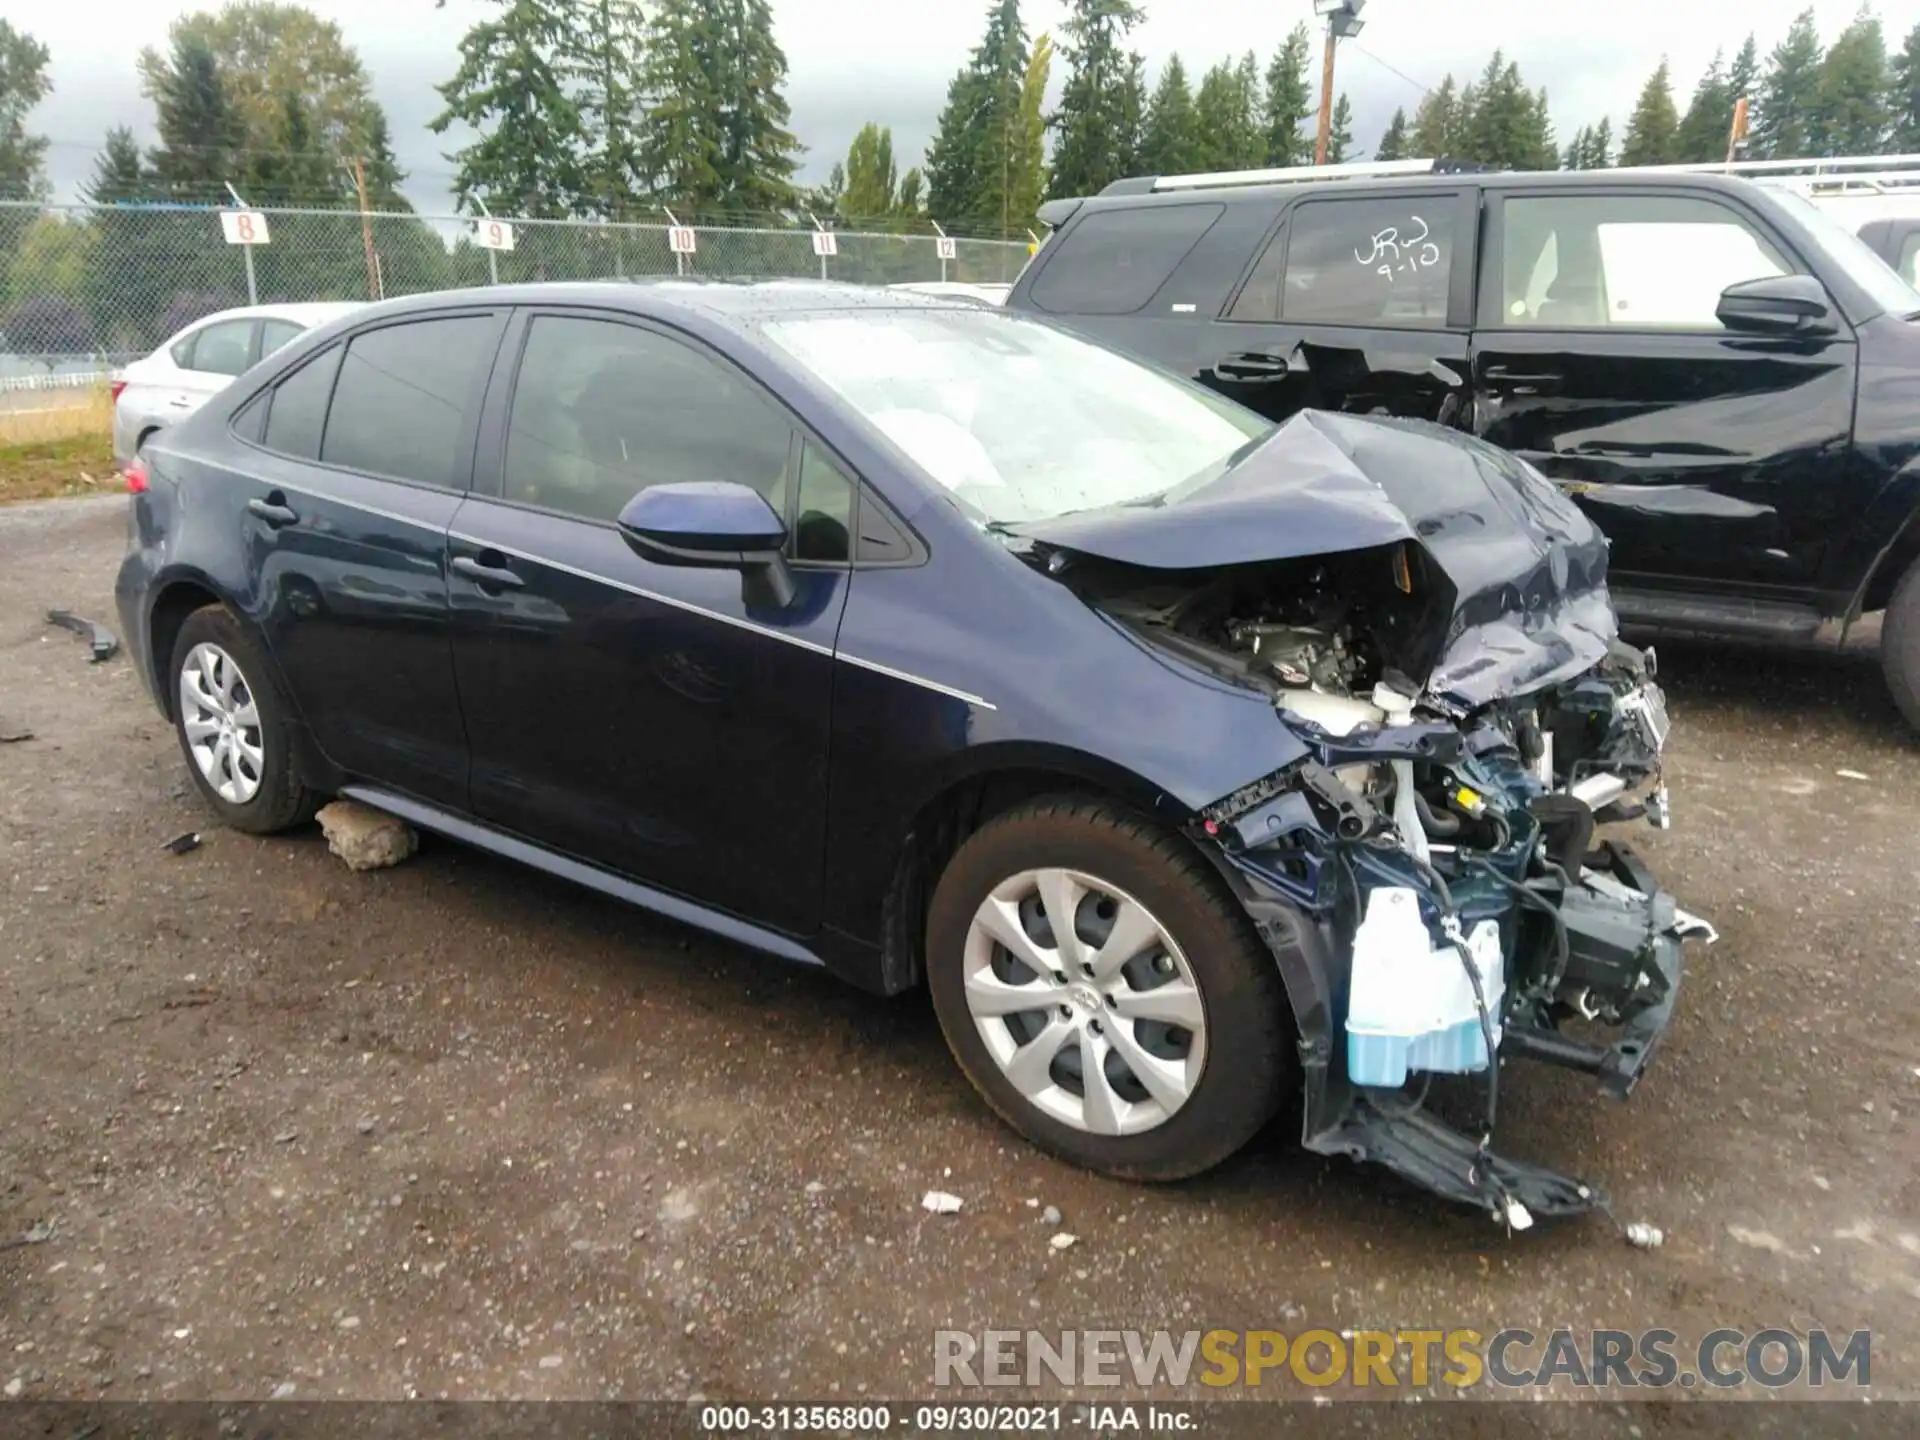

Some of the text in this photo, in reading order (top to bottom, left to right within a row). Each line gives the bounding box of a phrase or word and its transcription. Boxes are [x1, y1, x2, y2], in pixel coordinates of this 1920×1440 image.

[237, 213, 255, 241] 8
[489, 223, 503, 247] 9
[674, 229, 692, 249] 10
[818, 235, 832, 253] 11
[940, 239, 954, 257] 12
